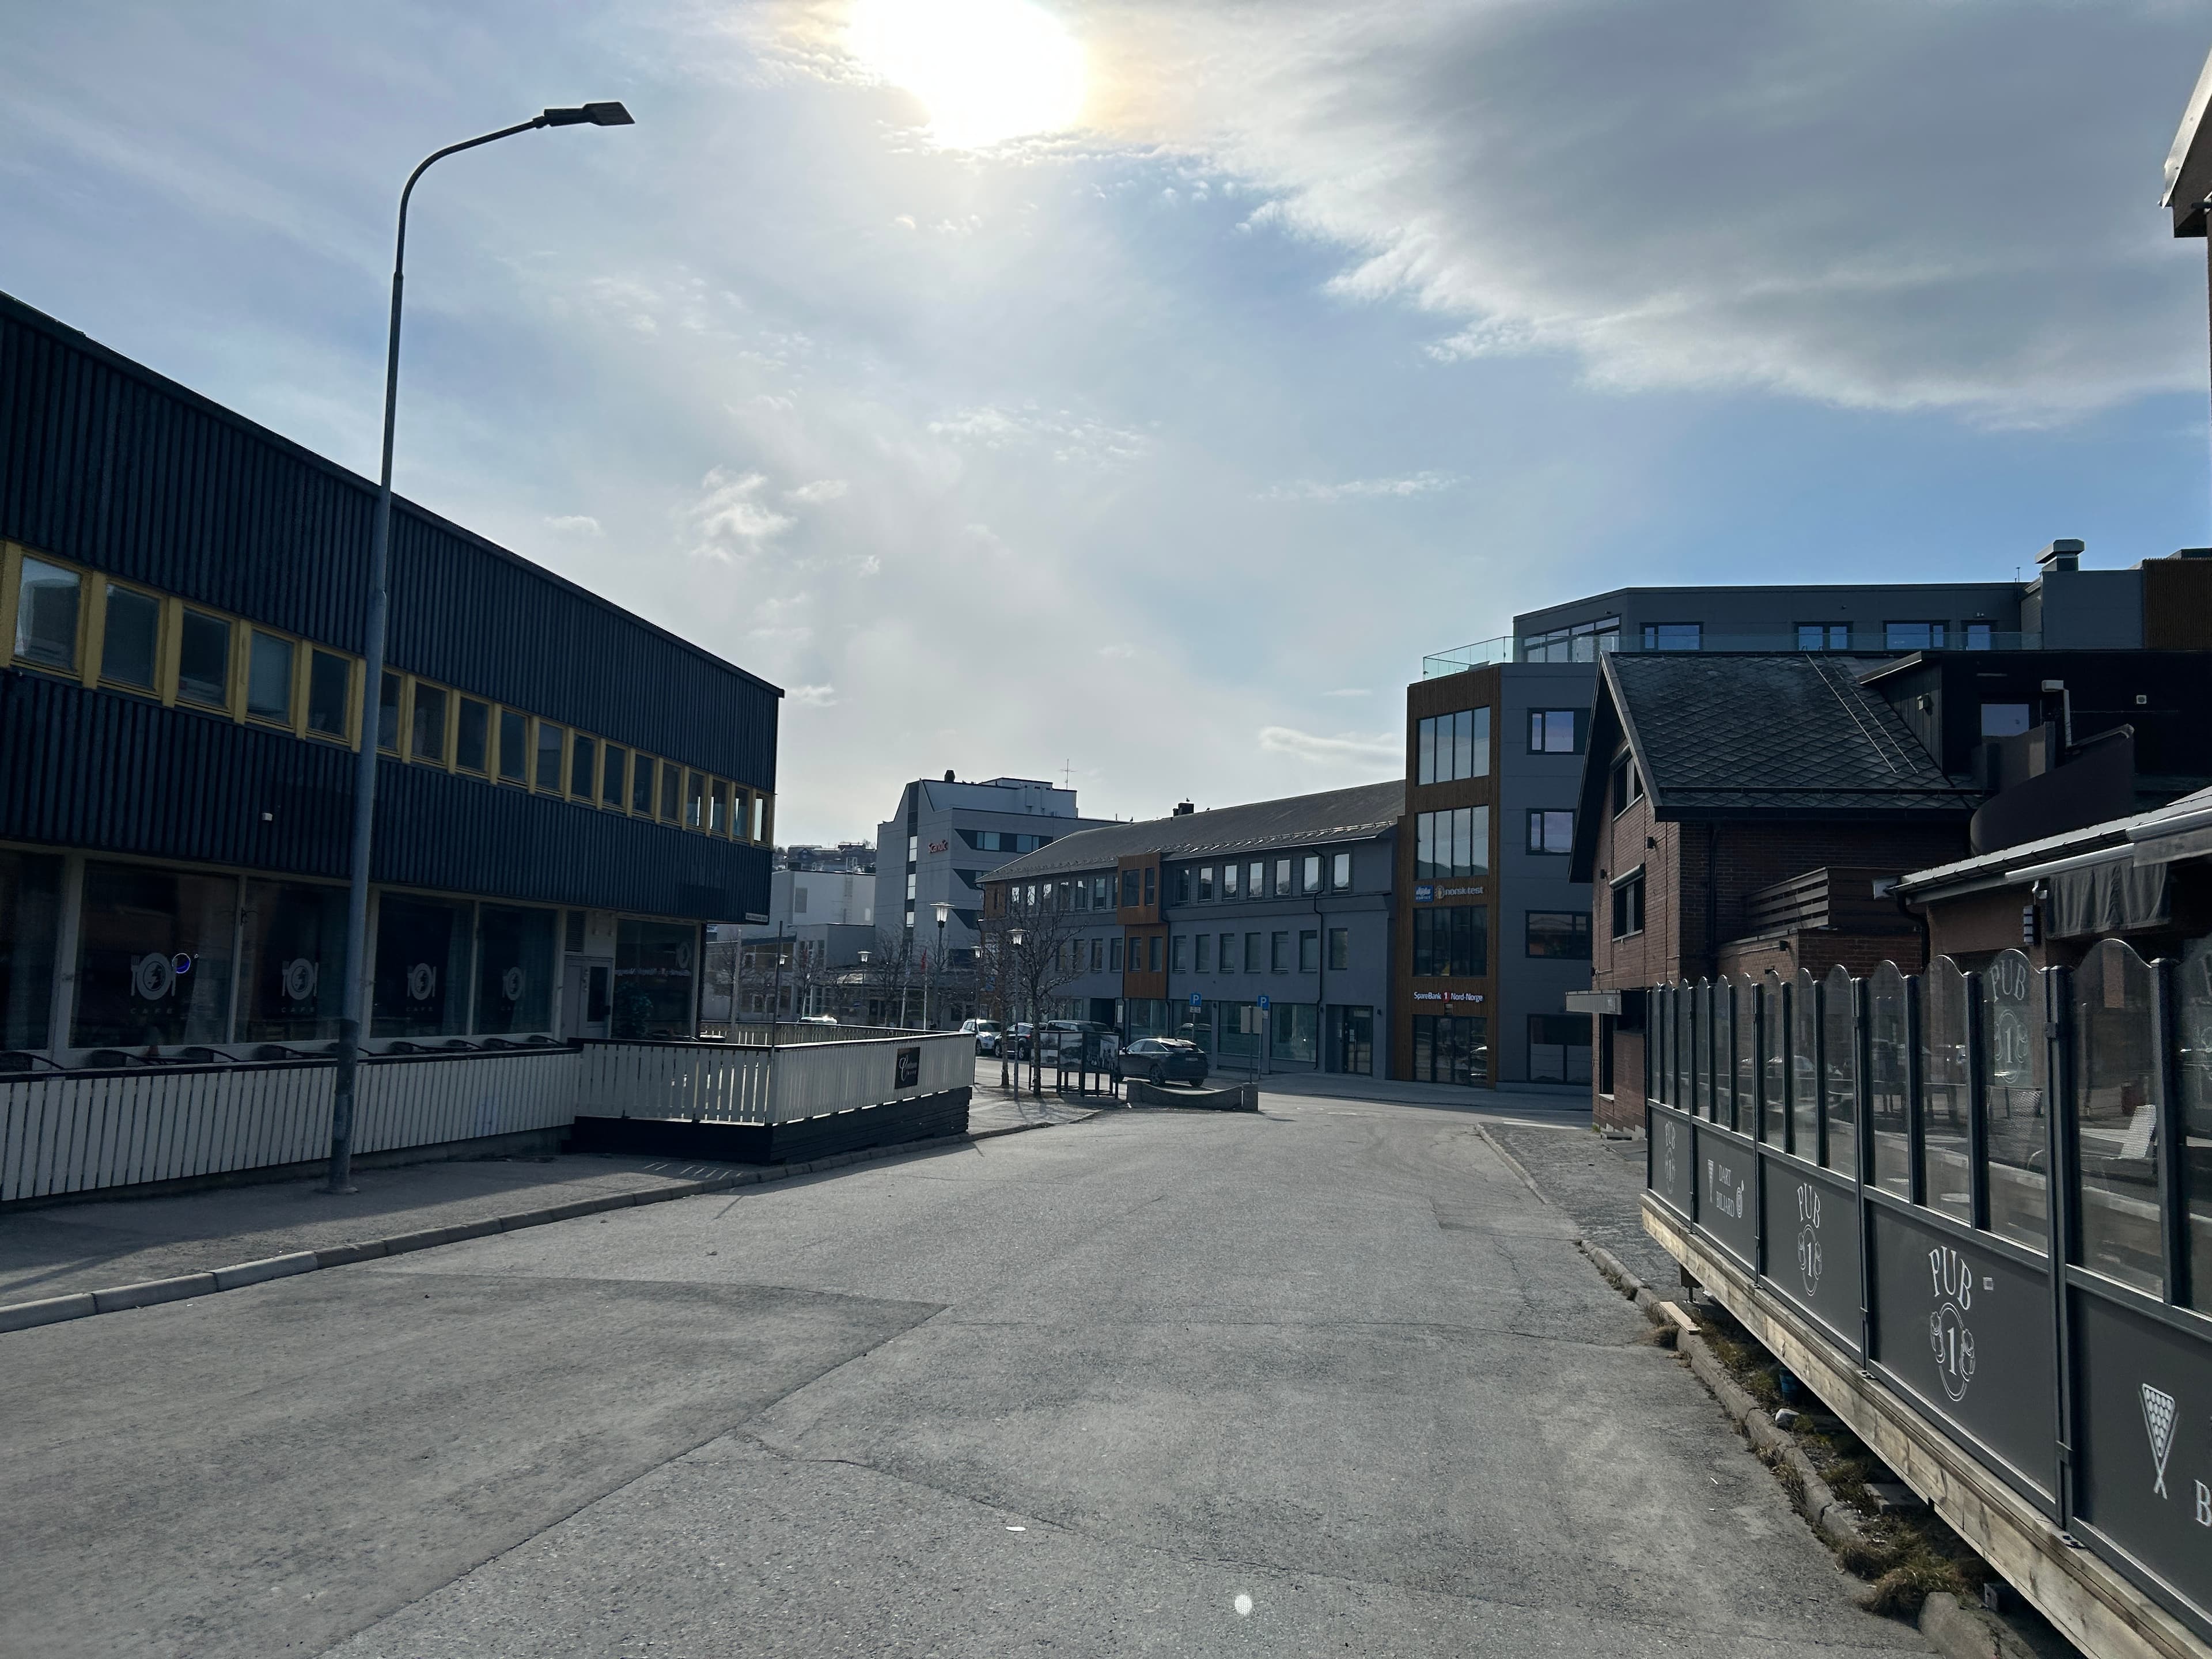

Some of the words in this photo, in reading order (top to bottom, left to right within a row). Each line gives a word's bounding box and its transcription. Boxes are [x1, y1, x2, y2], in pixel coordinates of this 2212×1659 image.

[1445, 887, 1467, 896] norsk
[1989, 959, 2027, 1003] PUB
[1193, 994, 1199, 1004] P
[1260, 997, 1267, 1006] P
[1414, 991, 1442, 1000] SpareBank
[1450, 992, 1483, 1003] Nord-Norge
[1665, 1121, 1676, 1149] PUB
[1719, 1164, 1732, 1187] DART
[1797, 1182, 1820, 1229] PUB
[1807, 1242, 1812, 1277] 1
[1928, 1245, 1972, 1310] PUB
[1947, 1327, 1957, 1376] 1
